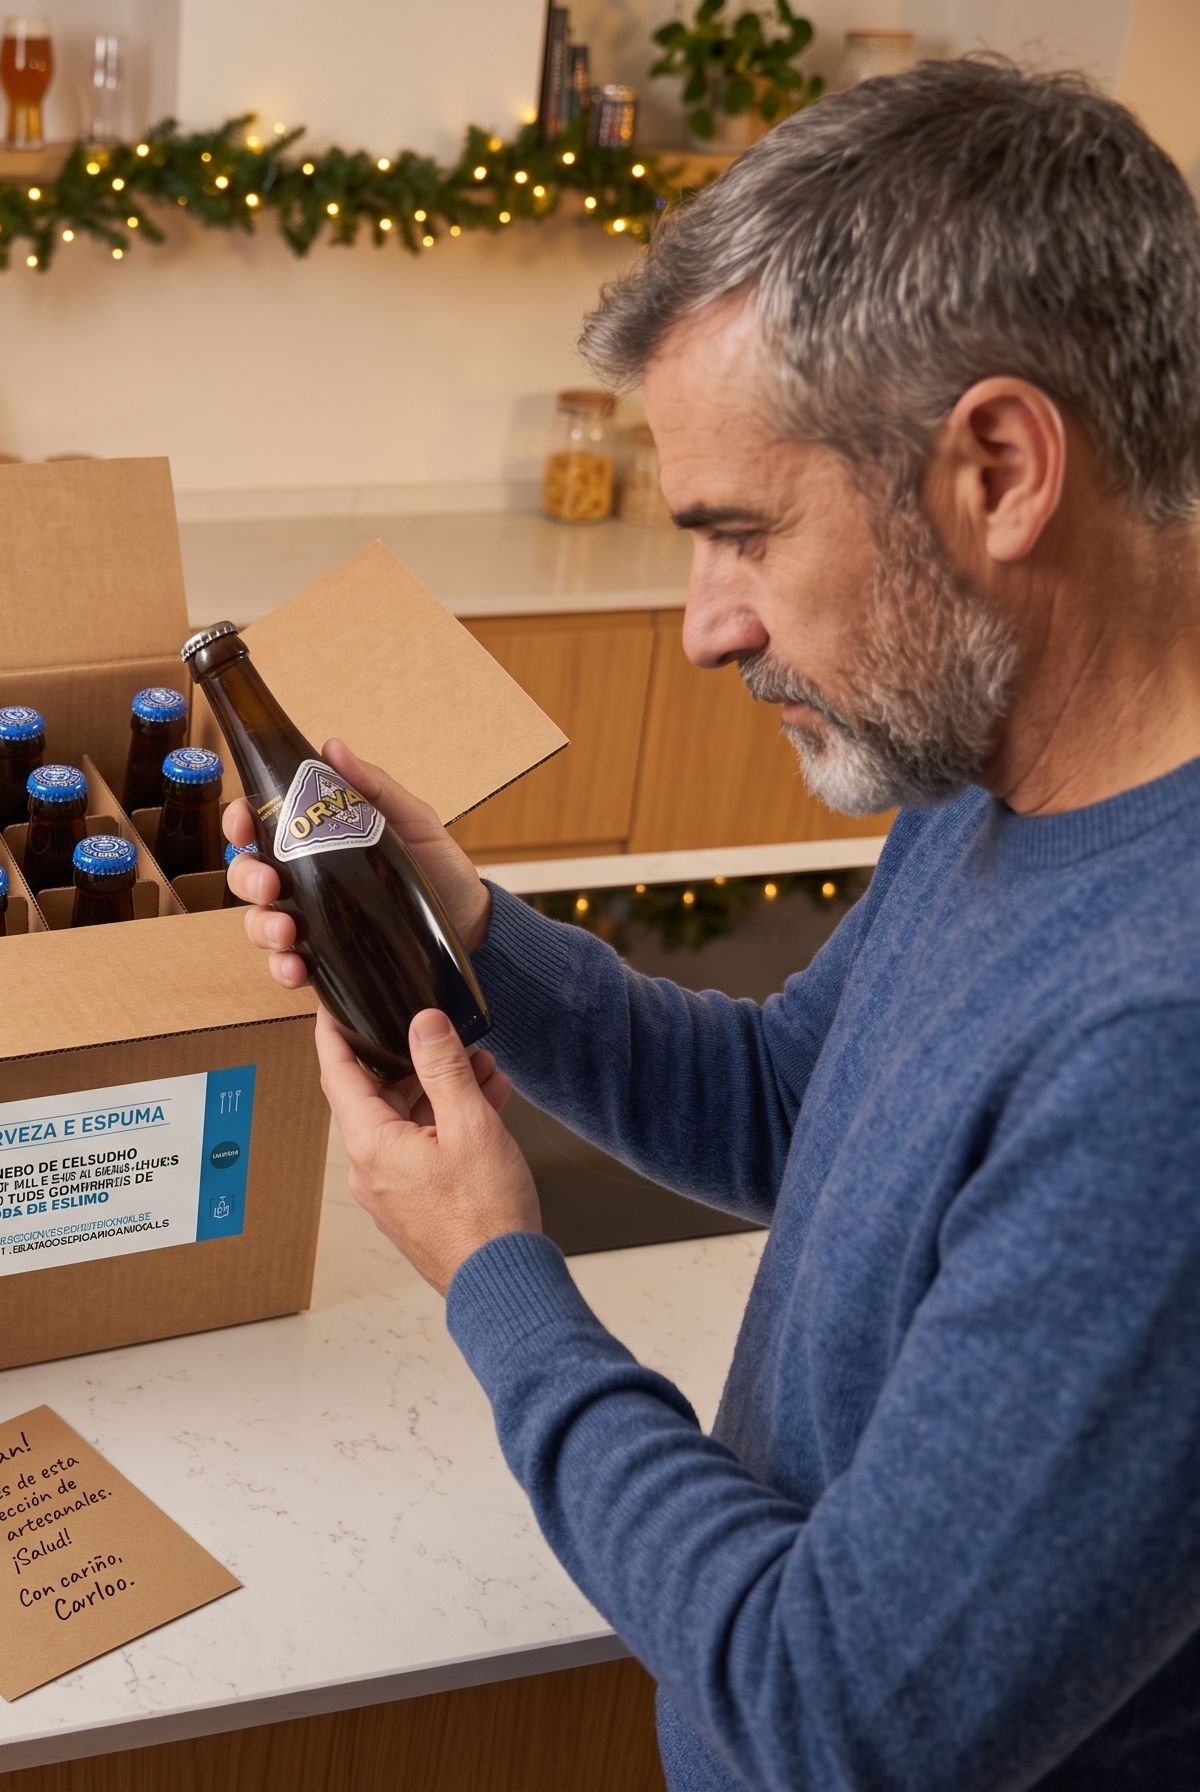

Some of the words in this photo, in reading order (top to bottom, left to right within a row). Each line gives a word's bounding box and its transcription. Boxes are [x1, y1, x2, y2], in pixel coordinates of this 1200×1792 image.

[64, 1119, 76, 1136] E
[81, 1105, 165, 1133] ESPUMA
[39, 1160, 58, 1173] DE
[62, 1148, 138, 1169] CELSUDHO
[7, 1189, 45, 1205] TUDS
[135, 1171, 154, 1184] DE
[51, 1191, 110, 1211] ESLIMO
[17, 1473, 37, 1490] de
[41, 1457, 80, 1479] esta
[57, 1478, 77, 1495] de
[7, 1489, 112, 1542] artesanales.
[12, 1527, 73, 1575] ¡Salud!
[19, 1586, 56, 1607] Con
[60, 1554, 123, 1588] cariño,
